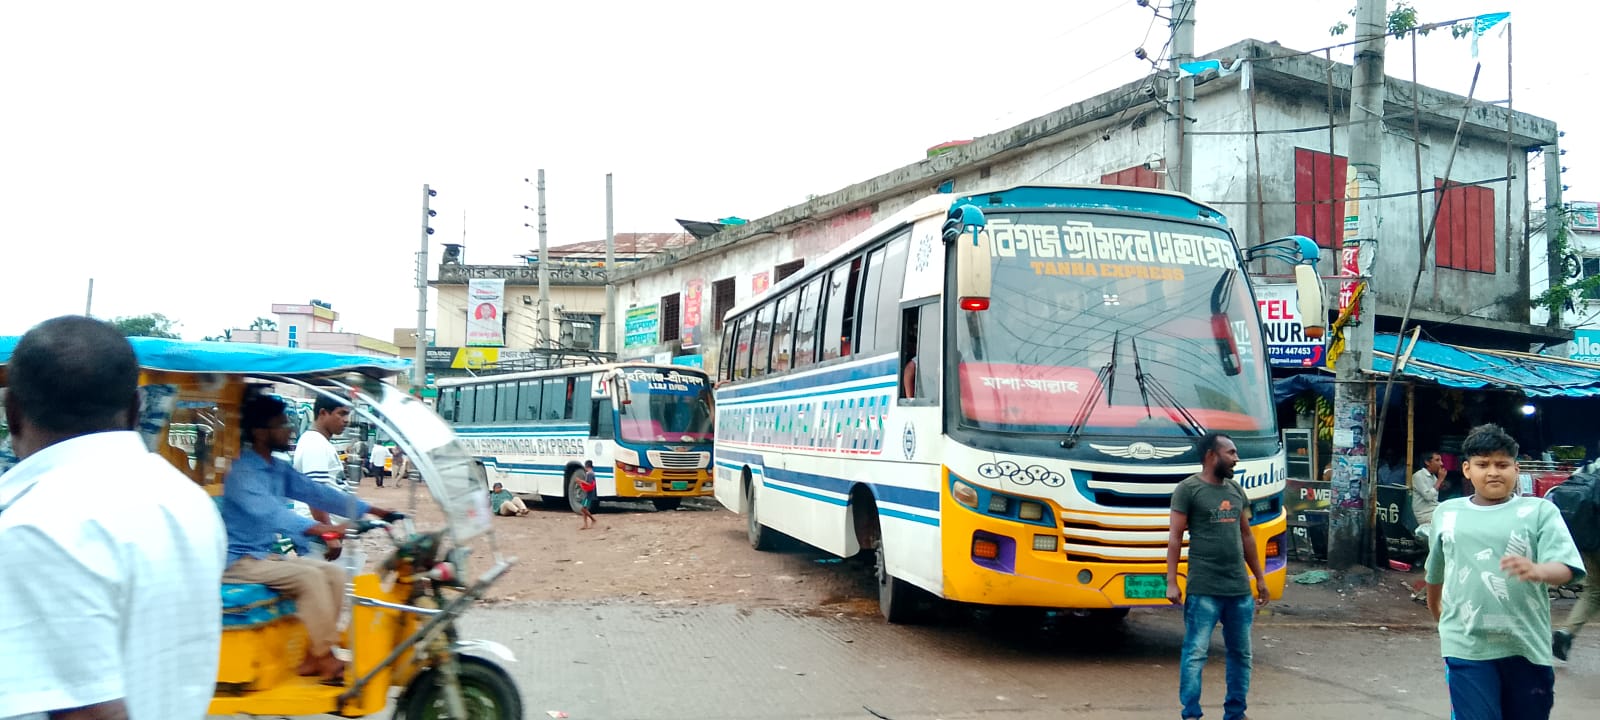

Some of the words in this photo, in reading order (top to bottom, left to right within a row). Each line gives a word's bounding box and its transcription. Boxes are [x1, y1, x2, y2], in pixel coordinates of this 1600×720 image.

[983, 219, 1062, 258] বিগঞ্জ
[1100, 265, 1185, 281] EXPRESS
[1257, 300, 1294, 319] TEL
[1267, 347, 1284, 355] 1731
[1284, 347, 1311, 355] 447453
[1270, 357, 1302, 365] @gmail.com
[540, 438, 585, 456] EXPRESS
[1300, 488, 1332, 501] POWE
